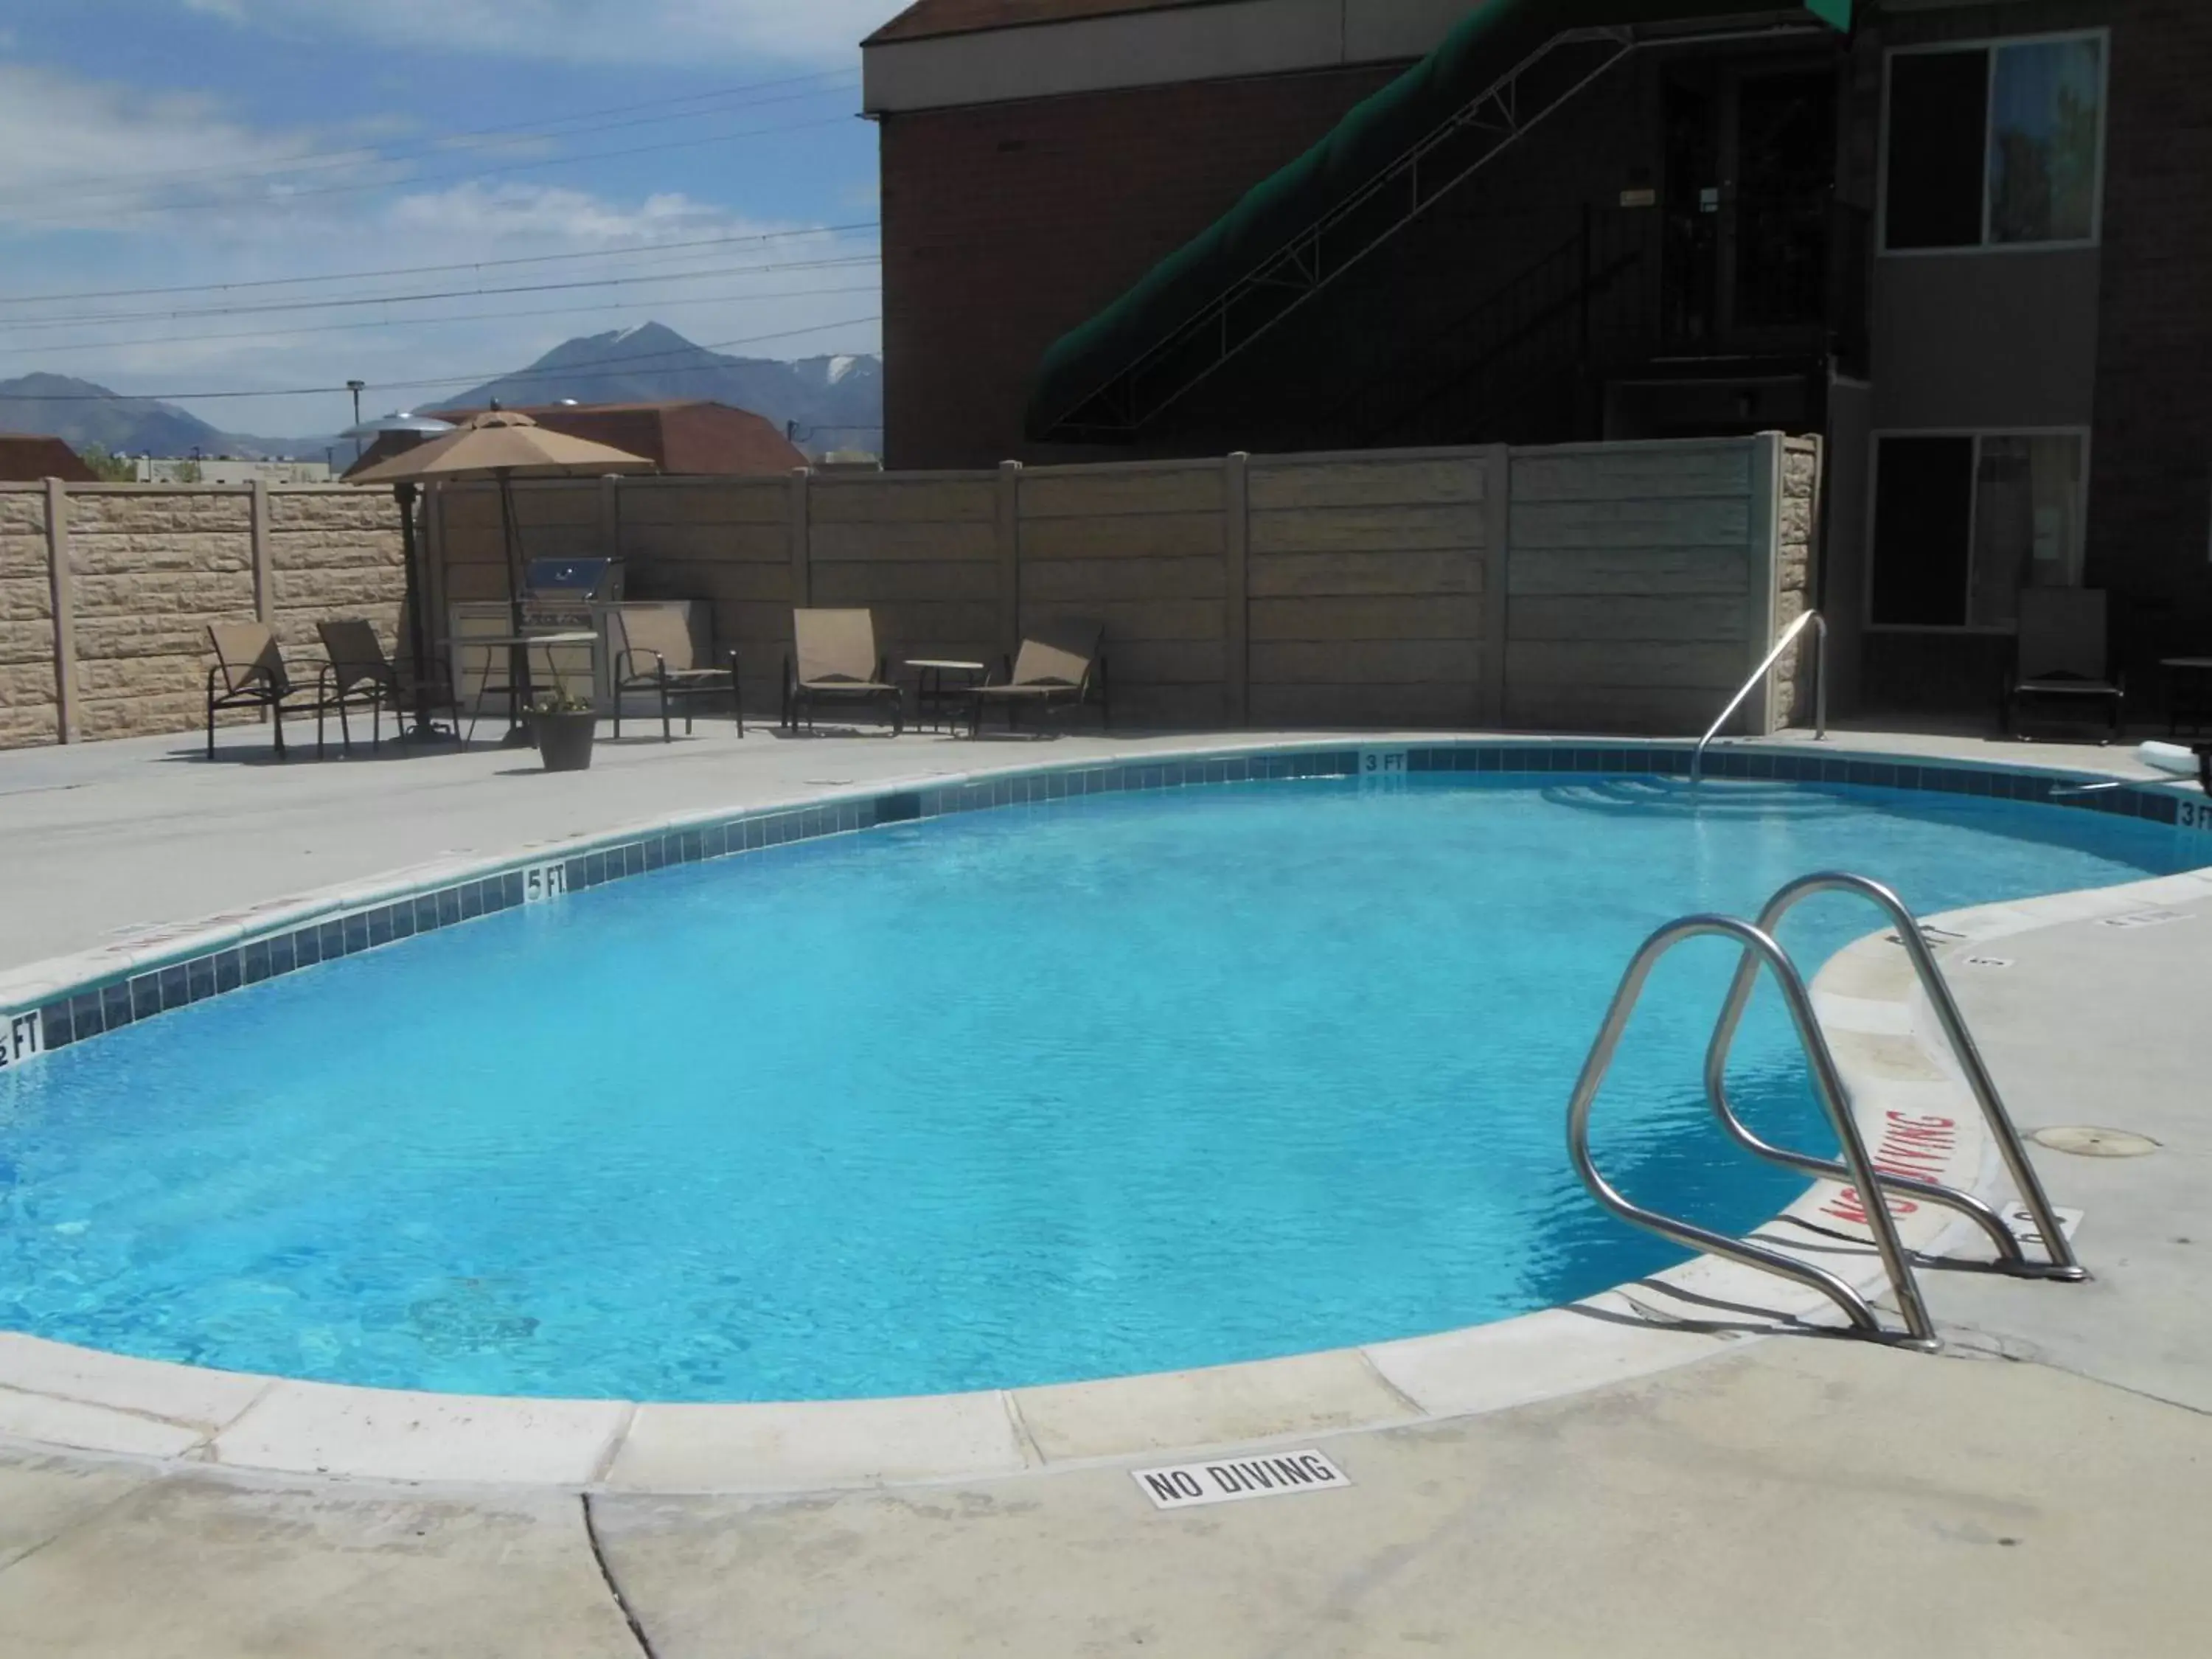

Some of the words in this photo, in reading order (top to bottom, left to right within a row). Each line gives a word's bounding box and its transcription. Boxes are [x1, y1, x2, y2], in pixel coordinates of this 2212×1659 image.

[1366, 754, 1377, 772] 3
[1384, 754, 1405, 772] FT
[2182, 801, 2194, 827] 3
[528, 869, 541, 900] 5
[547, 863, 563, 897] FT
[11, 1012, 38, 1060] FT
[1144, 1470, 1203, 1501] NO
[1206, 1455, 1336, 1494] DIVING
